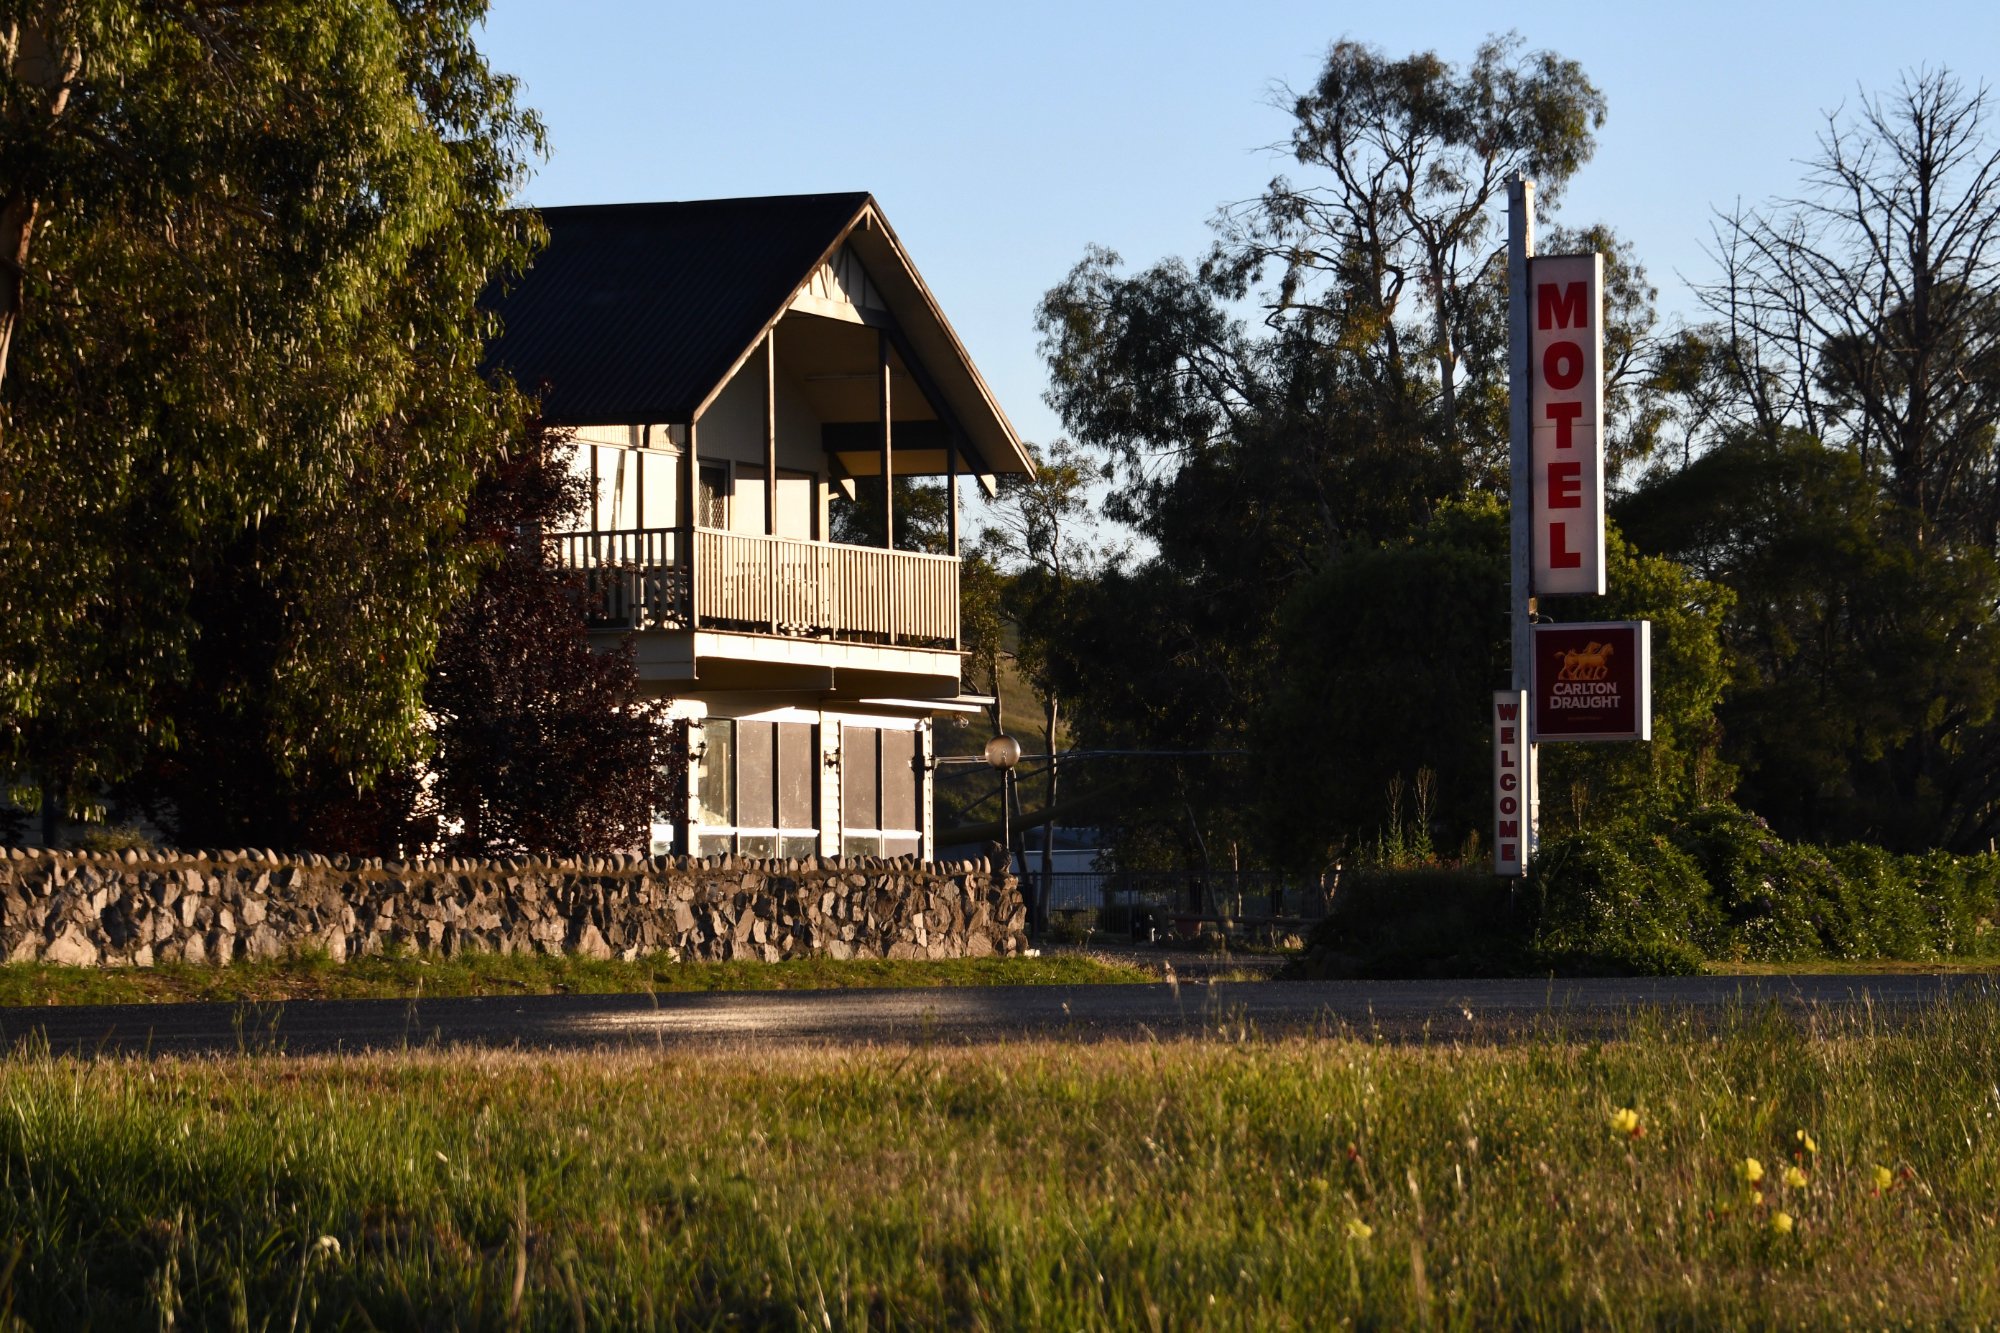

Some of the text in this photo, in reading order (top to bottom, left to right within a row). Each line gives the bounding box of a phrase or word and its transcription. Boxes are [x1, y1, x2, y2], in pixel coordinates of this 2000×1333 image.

[1538, 281, 1588, 569] MOTEL
[1550, 696, 1620, 709] DRAUGHT
[1553, 682, 1617, 695] CARLTON
[1497, 704, 1518, 861] WELCOME
